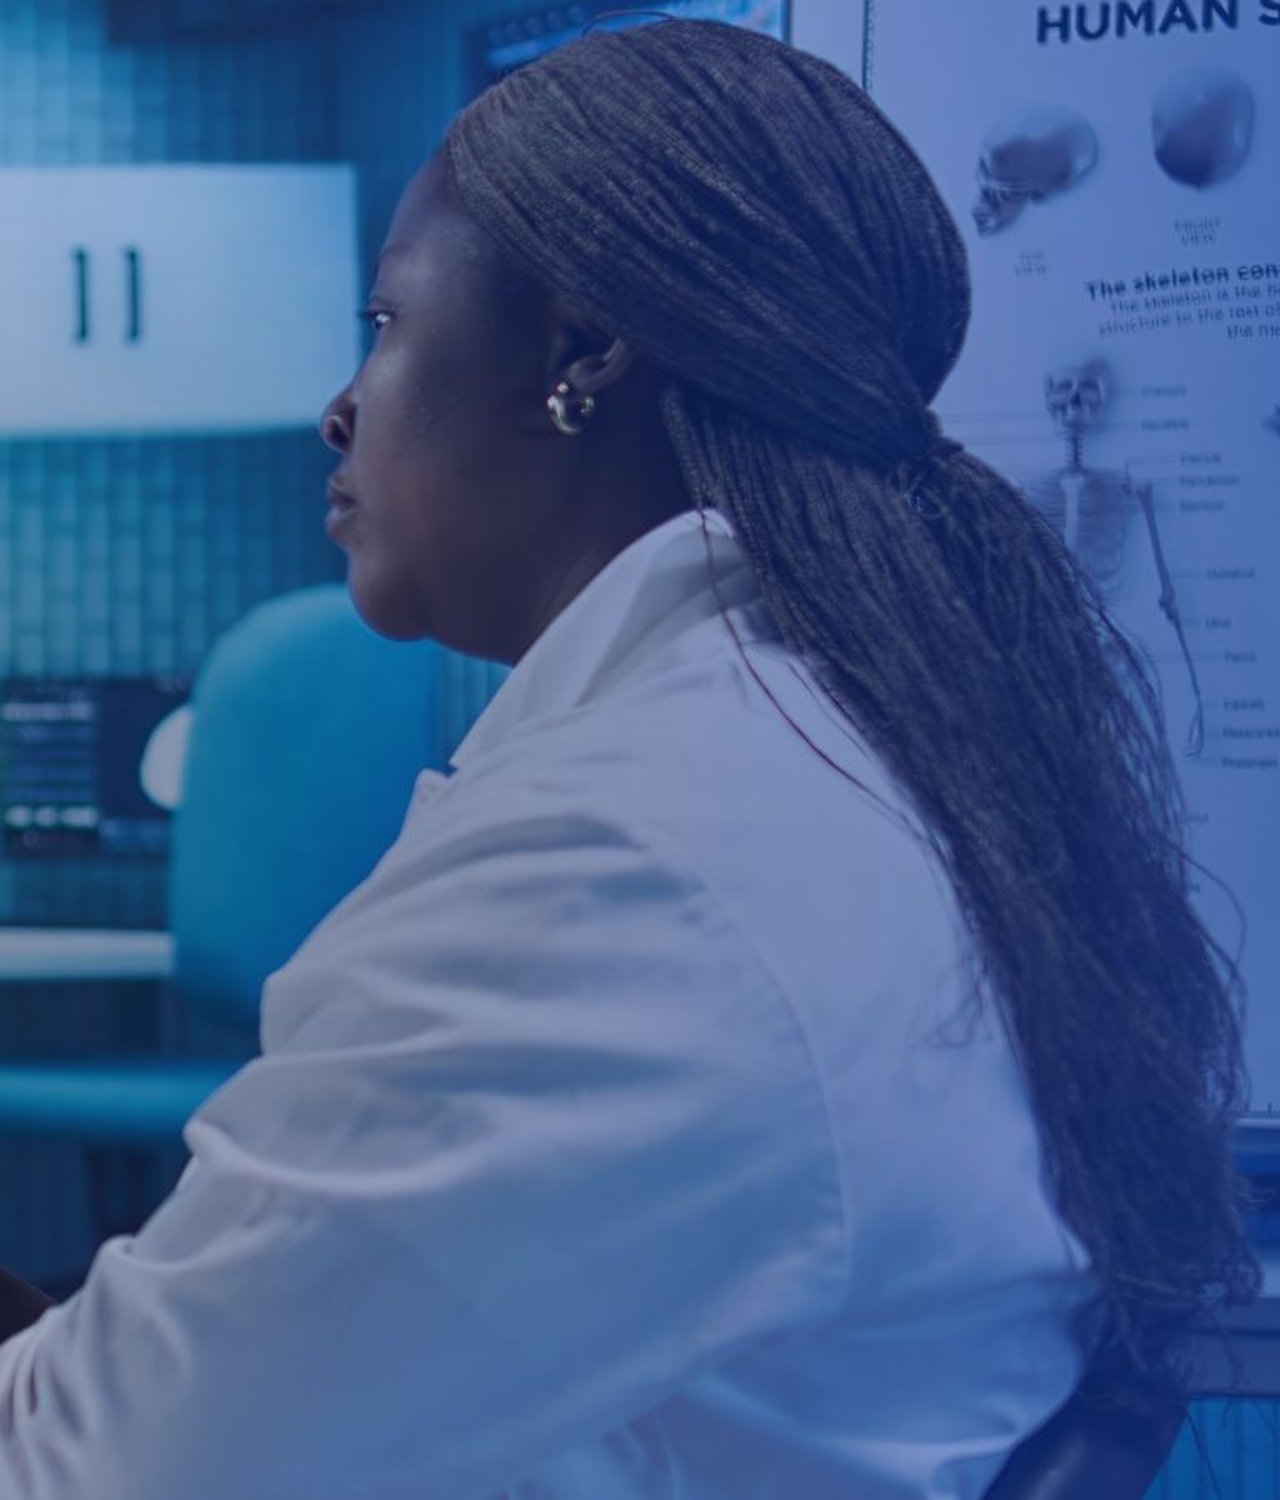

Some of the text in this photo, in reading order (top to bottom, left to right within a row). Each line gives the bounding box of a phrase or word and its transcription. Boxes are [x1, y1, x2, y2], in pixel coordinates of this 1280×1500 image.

[1037, 0, 1238, 44] HUMAN
[1083, 264, 1280, 302] The skeleton con
